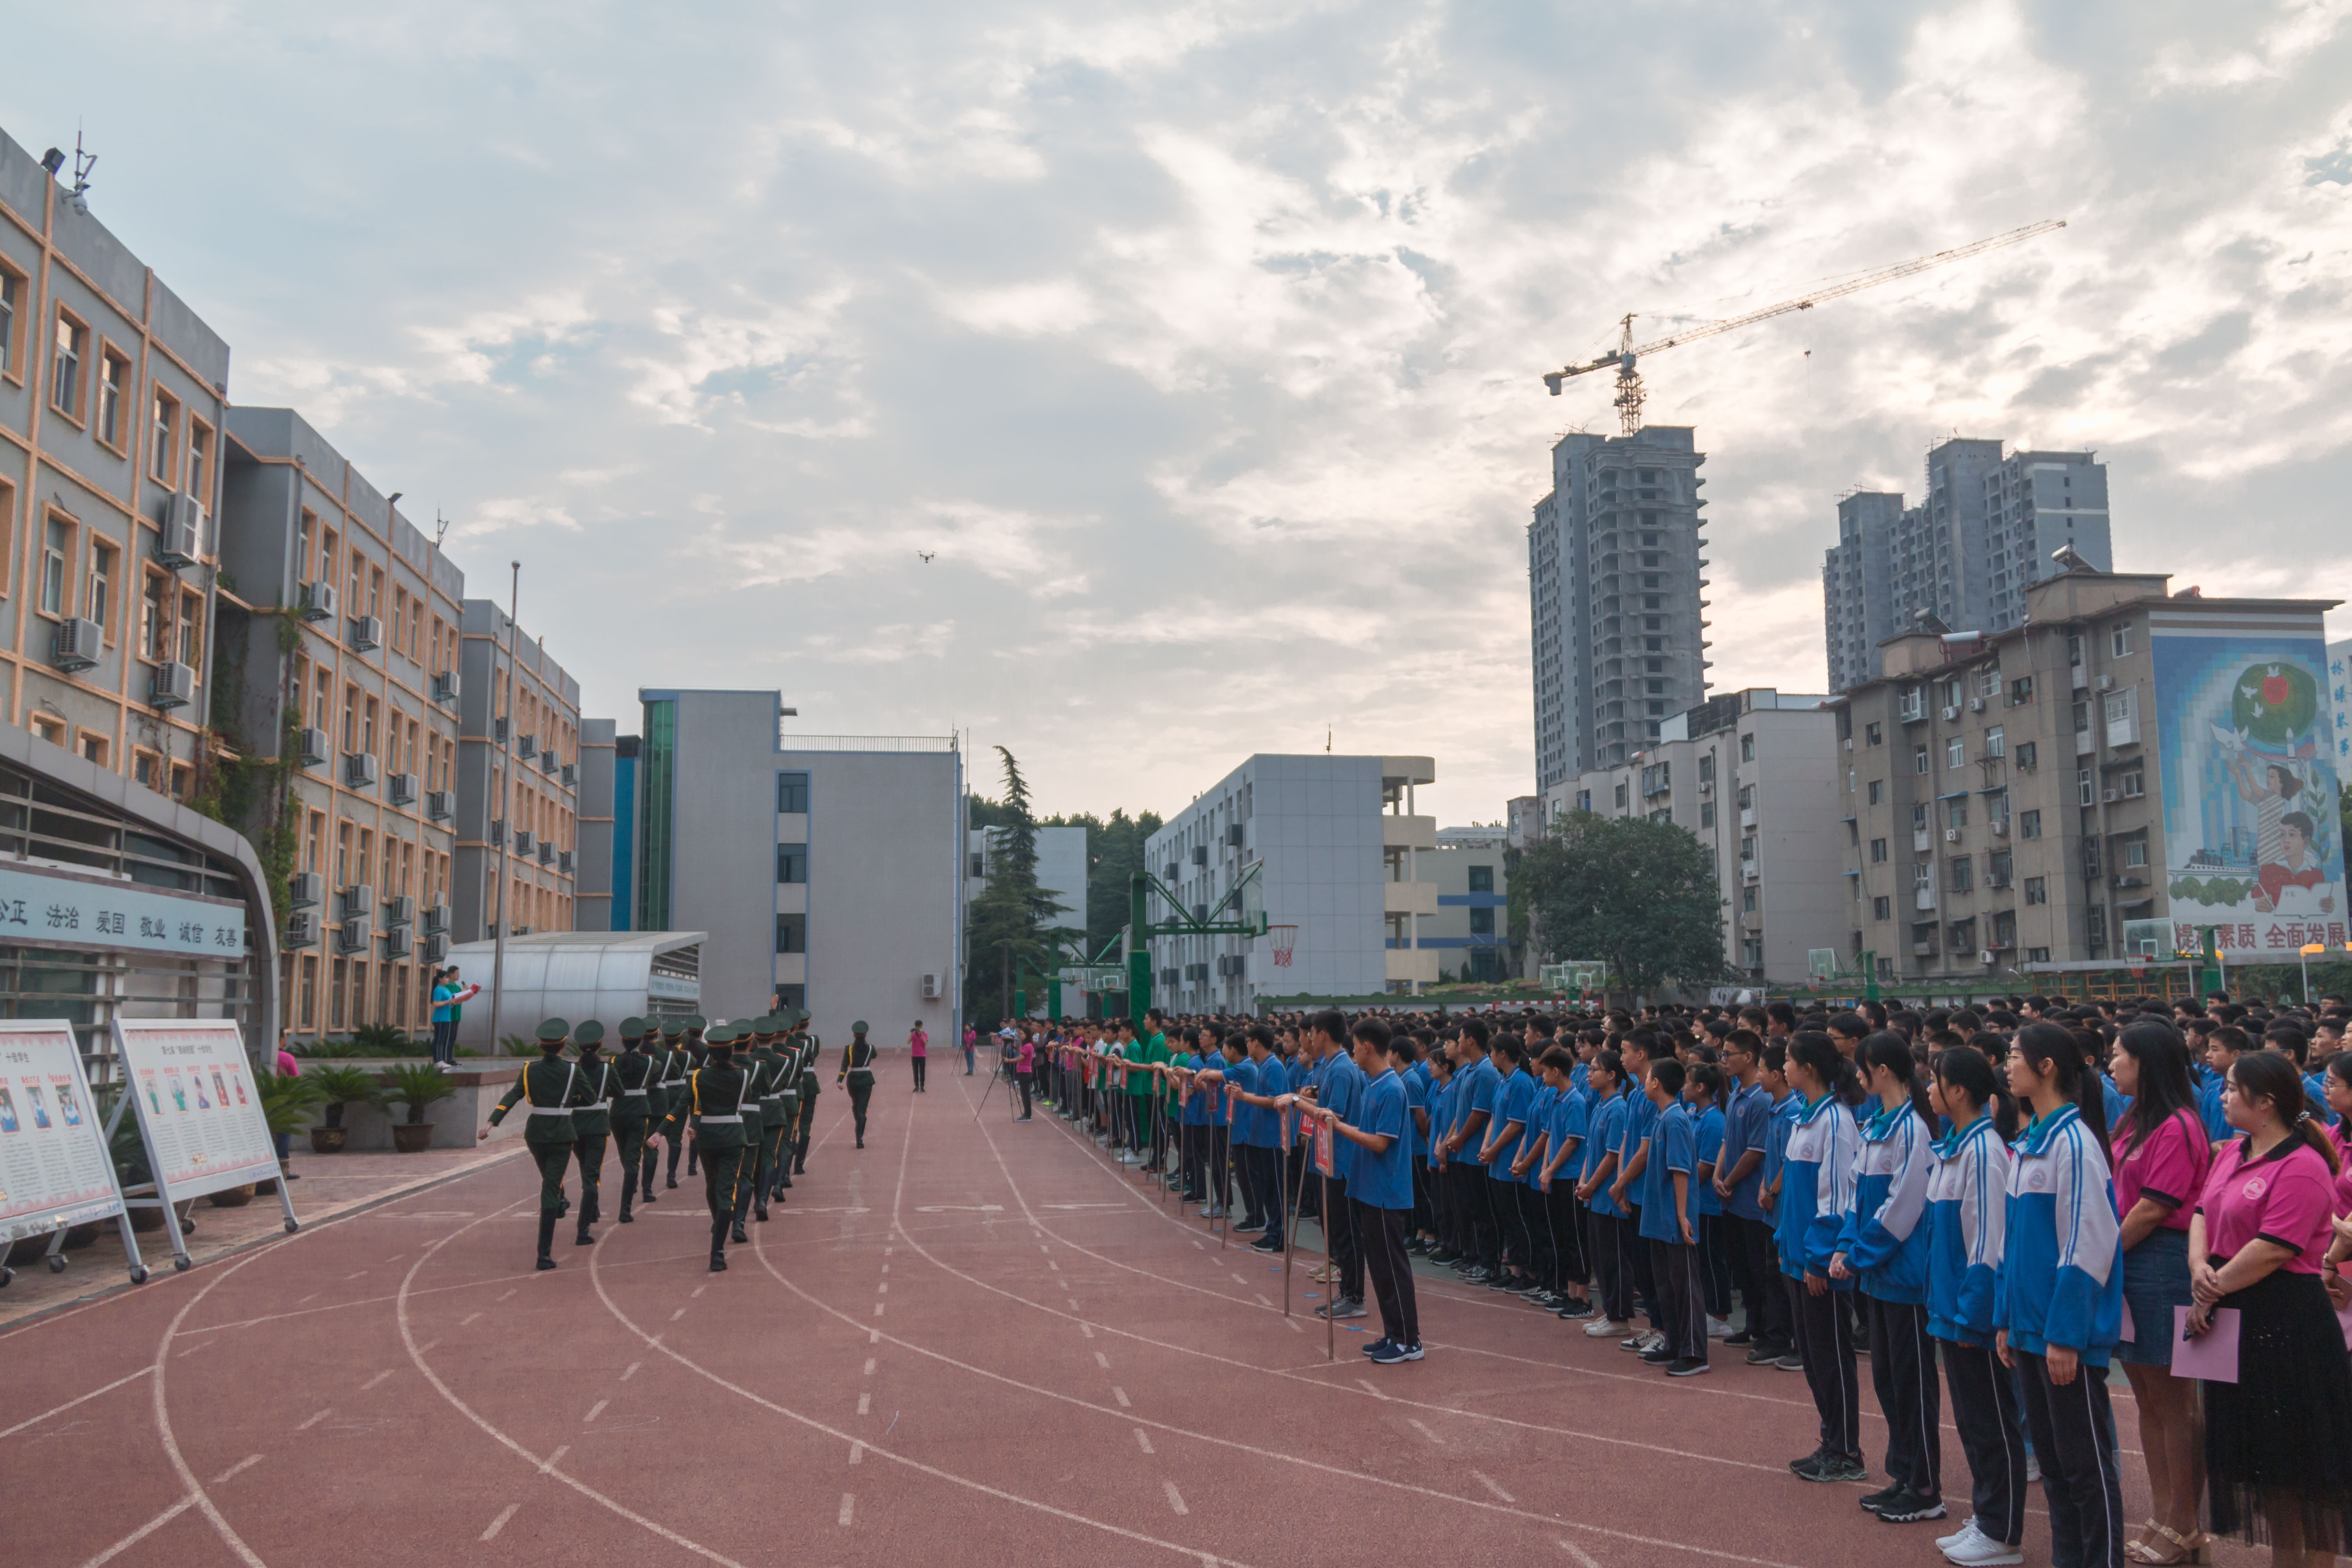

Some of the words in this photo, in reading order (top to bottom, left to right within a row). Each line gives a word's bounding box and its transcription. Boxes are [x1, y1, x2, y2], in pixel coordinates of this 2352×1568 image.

[46, 904, 80, 929] 法治
[96, 911, 125, 934] 爱国
[140, 915, 166, 940] 敬业
[179, 921, 204, 943] 诚信
[215, 926, 237, 947] 友善
[2176, 923, 2257, 949] 提素质
[2265, 922, 2346, 949] 全面发展
